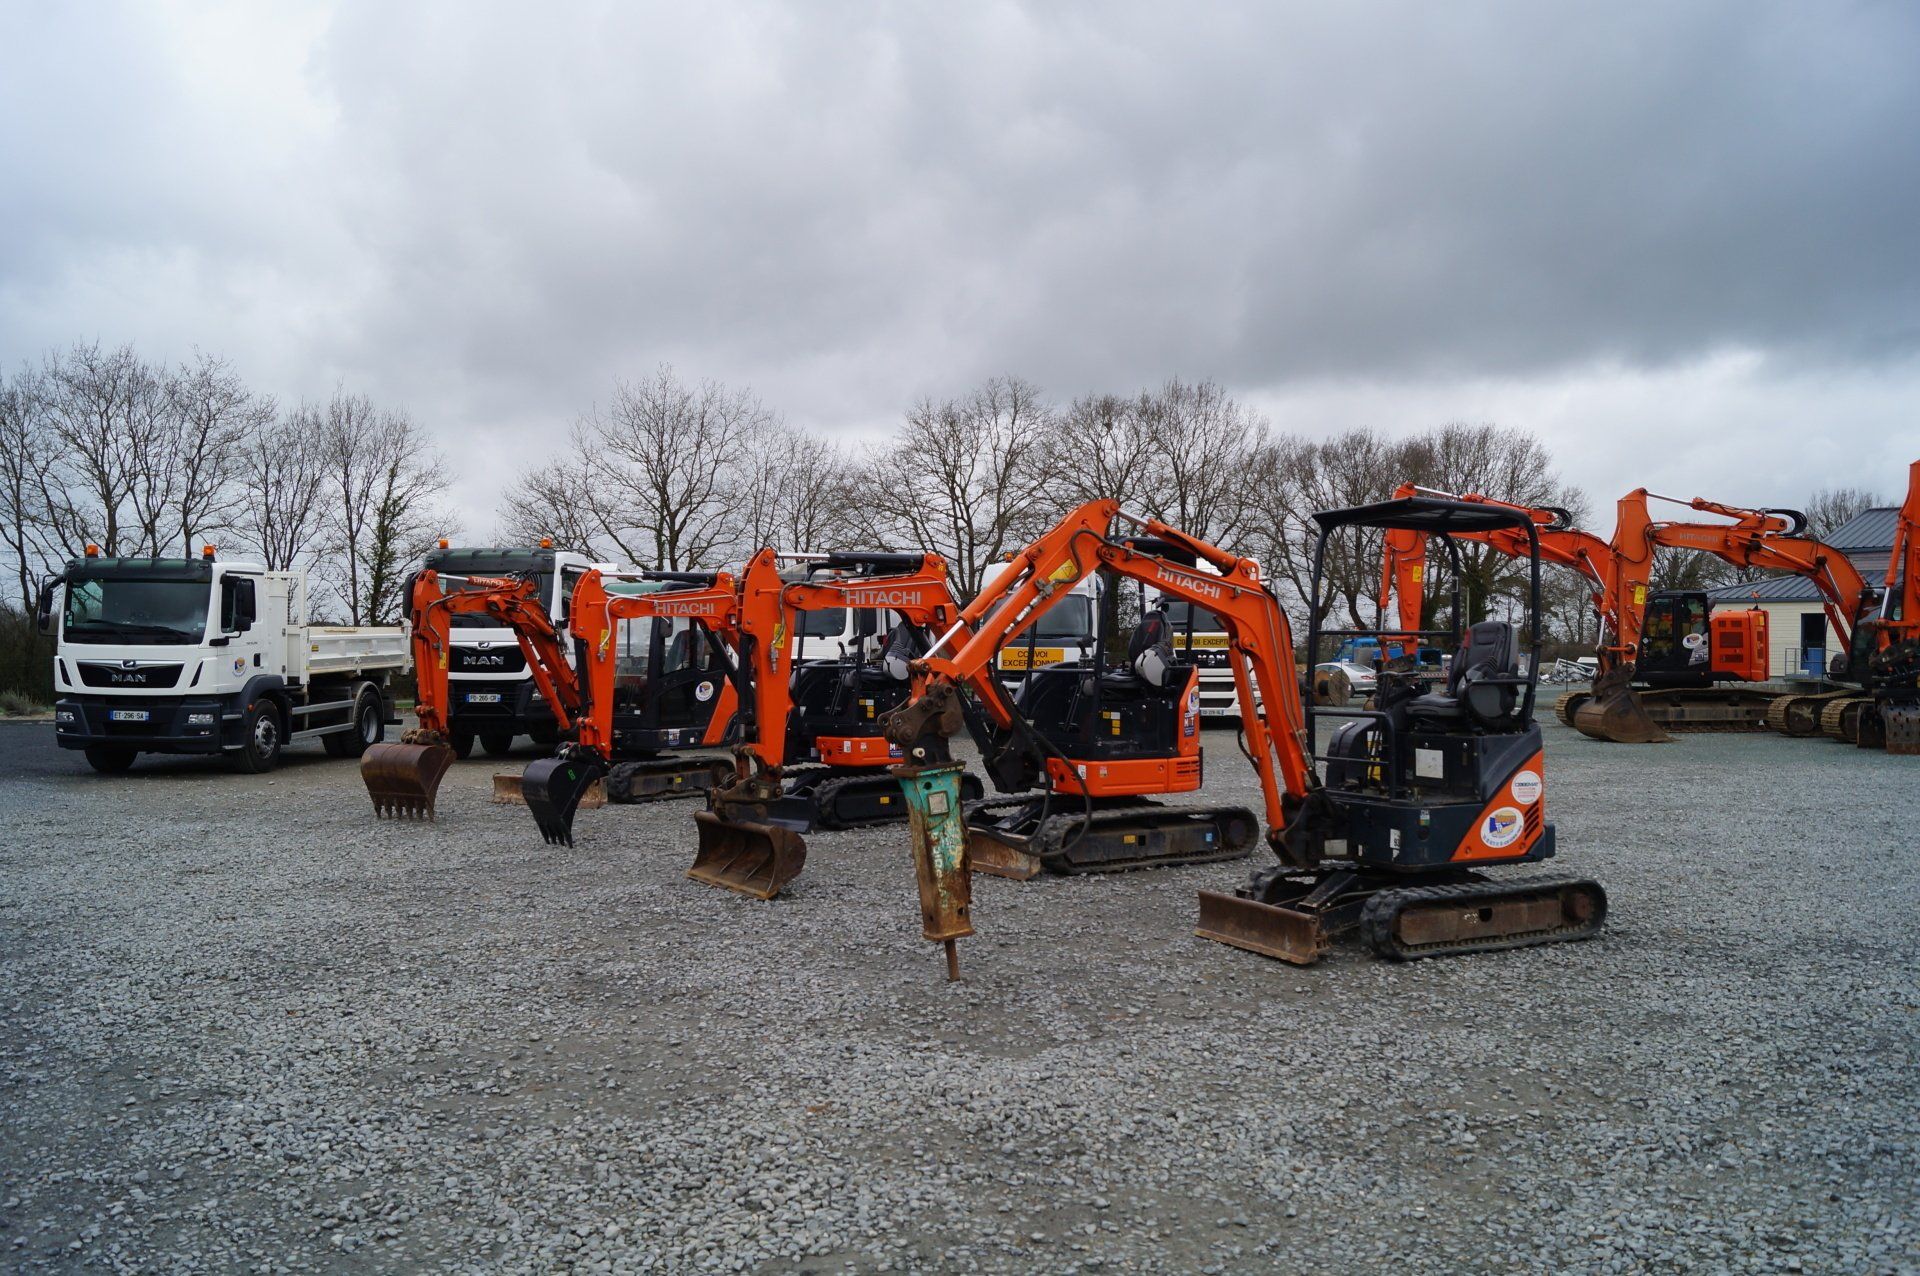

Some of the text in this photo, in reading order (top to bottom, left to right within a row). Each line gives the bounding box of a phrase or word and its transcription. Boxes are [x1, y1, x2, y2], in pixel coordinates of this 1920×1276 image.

[473, 577, 504, 587] HITACHI
[1157, 567, 1220, 599] HITACHI
[845, 591, 921, 605] HITACHI
[656, 602, 714, 614] HITACHI
[1017, 650, 1048, 658] COVOI
[463, 656, 504, 665] MAN
[112, 674, 147, 682] MAN
